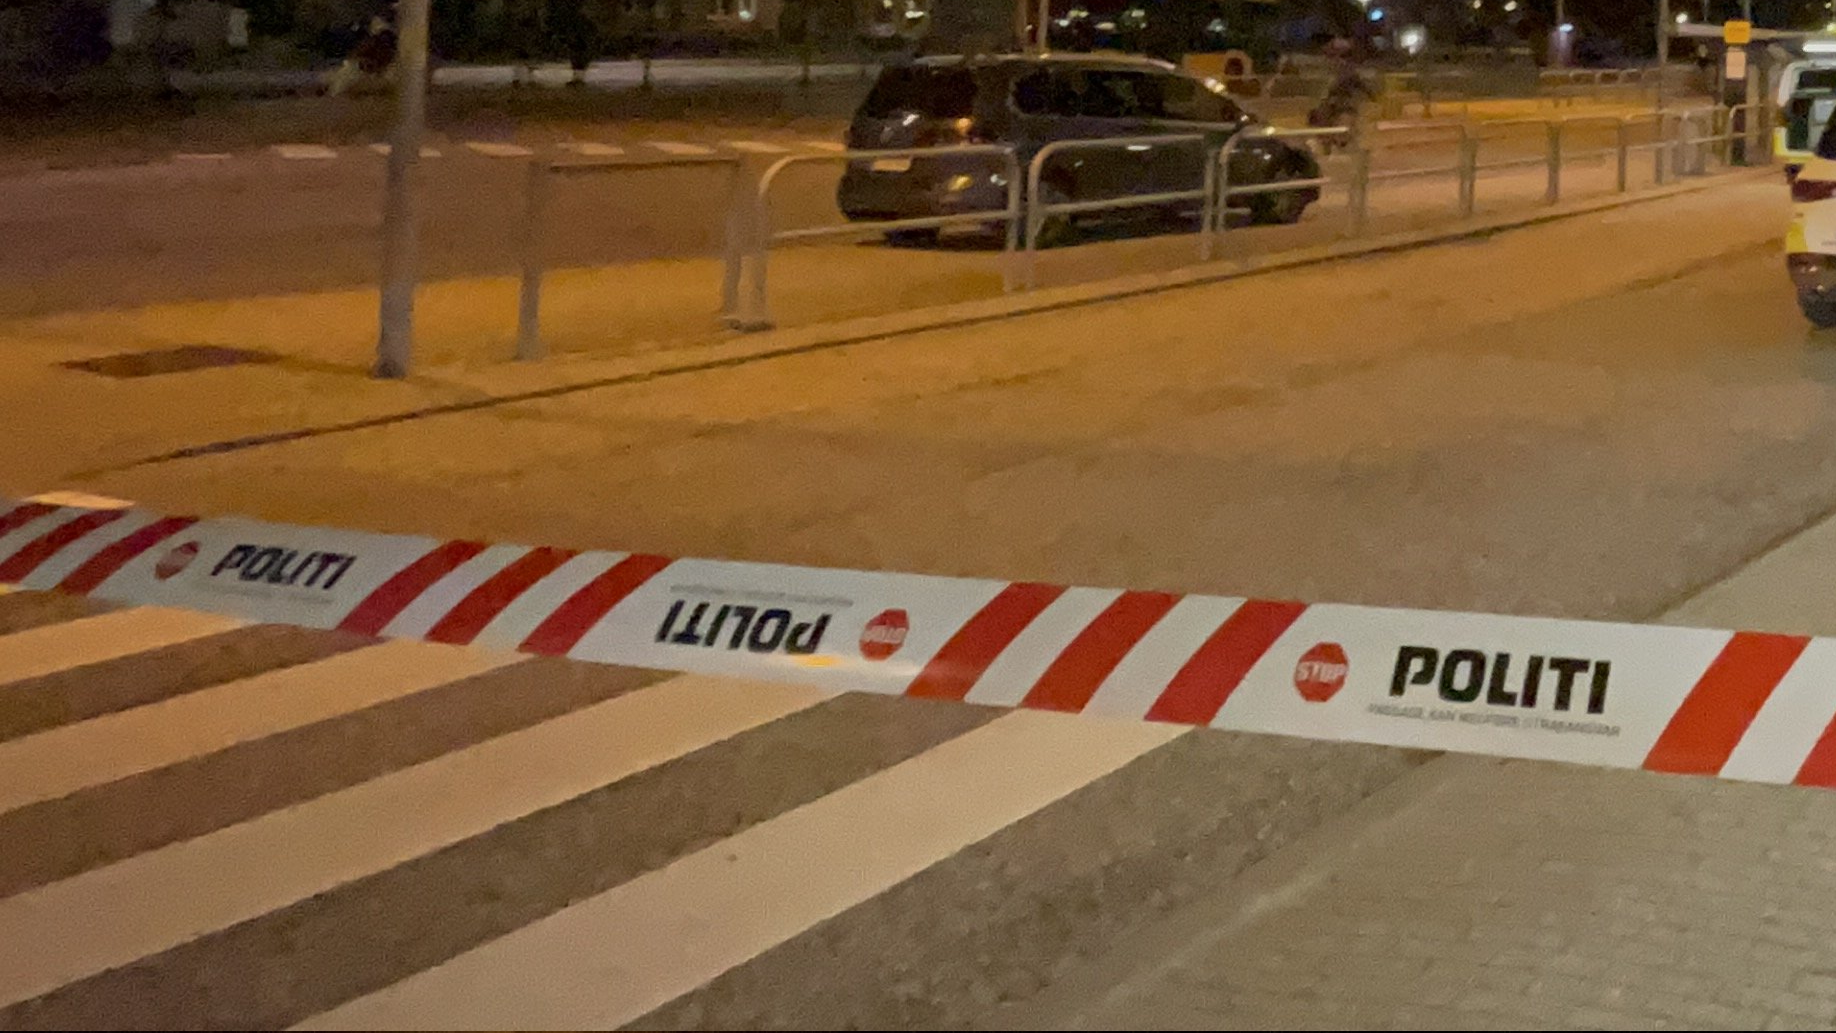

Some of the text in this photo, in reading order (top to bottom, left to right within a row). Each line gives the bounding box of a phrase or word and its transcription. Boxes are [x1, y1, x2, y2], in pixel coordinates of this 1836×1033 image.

[211, 542, 357, 591] POLITI
[655, 599, 832, 655] POLITI
[1295, 660, 1347, 683] STOP
[1389, 645, 1611, 715] POLITI
